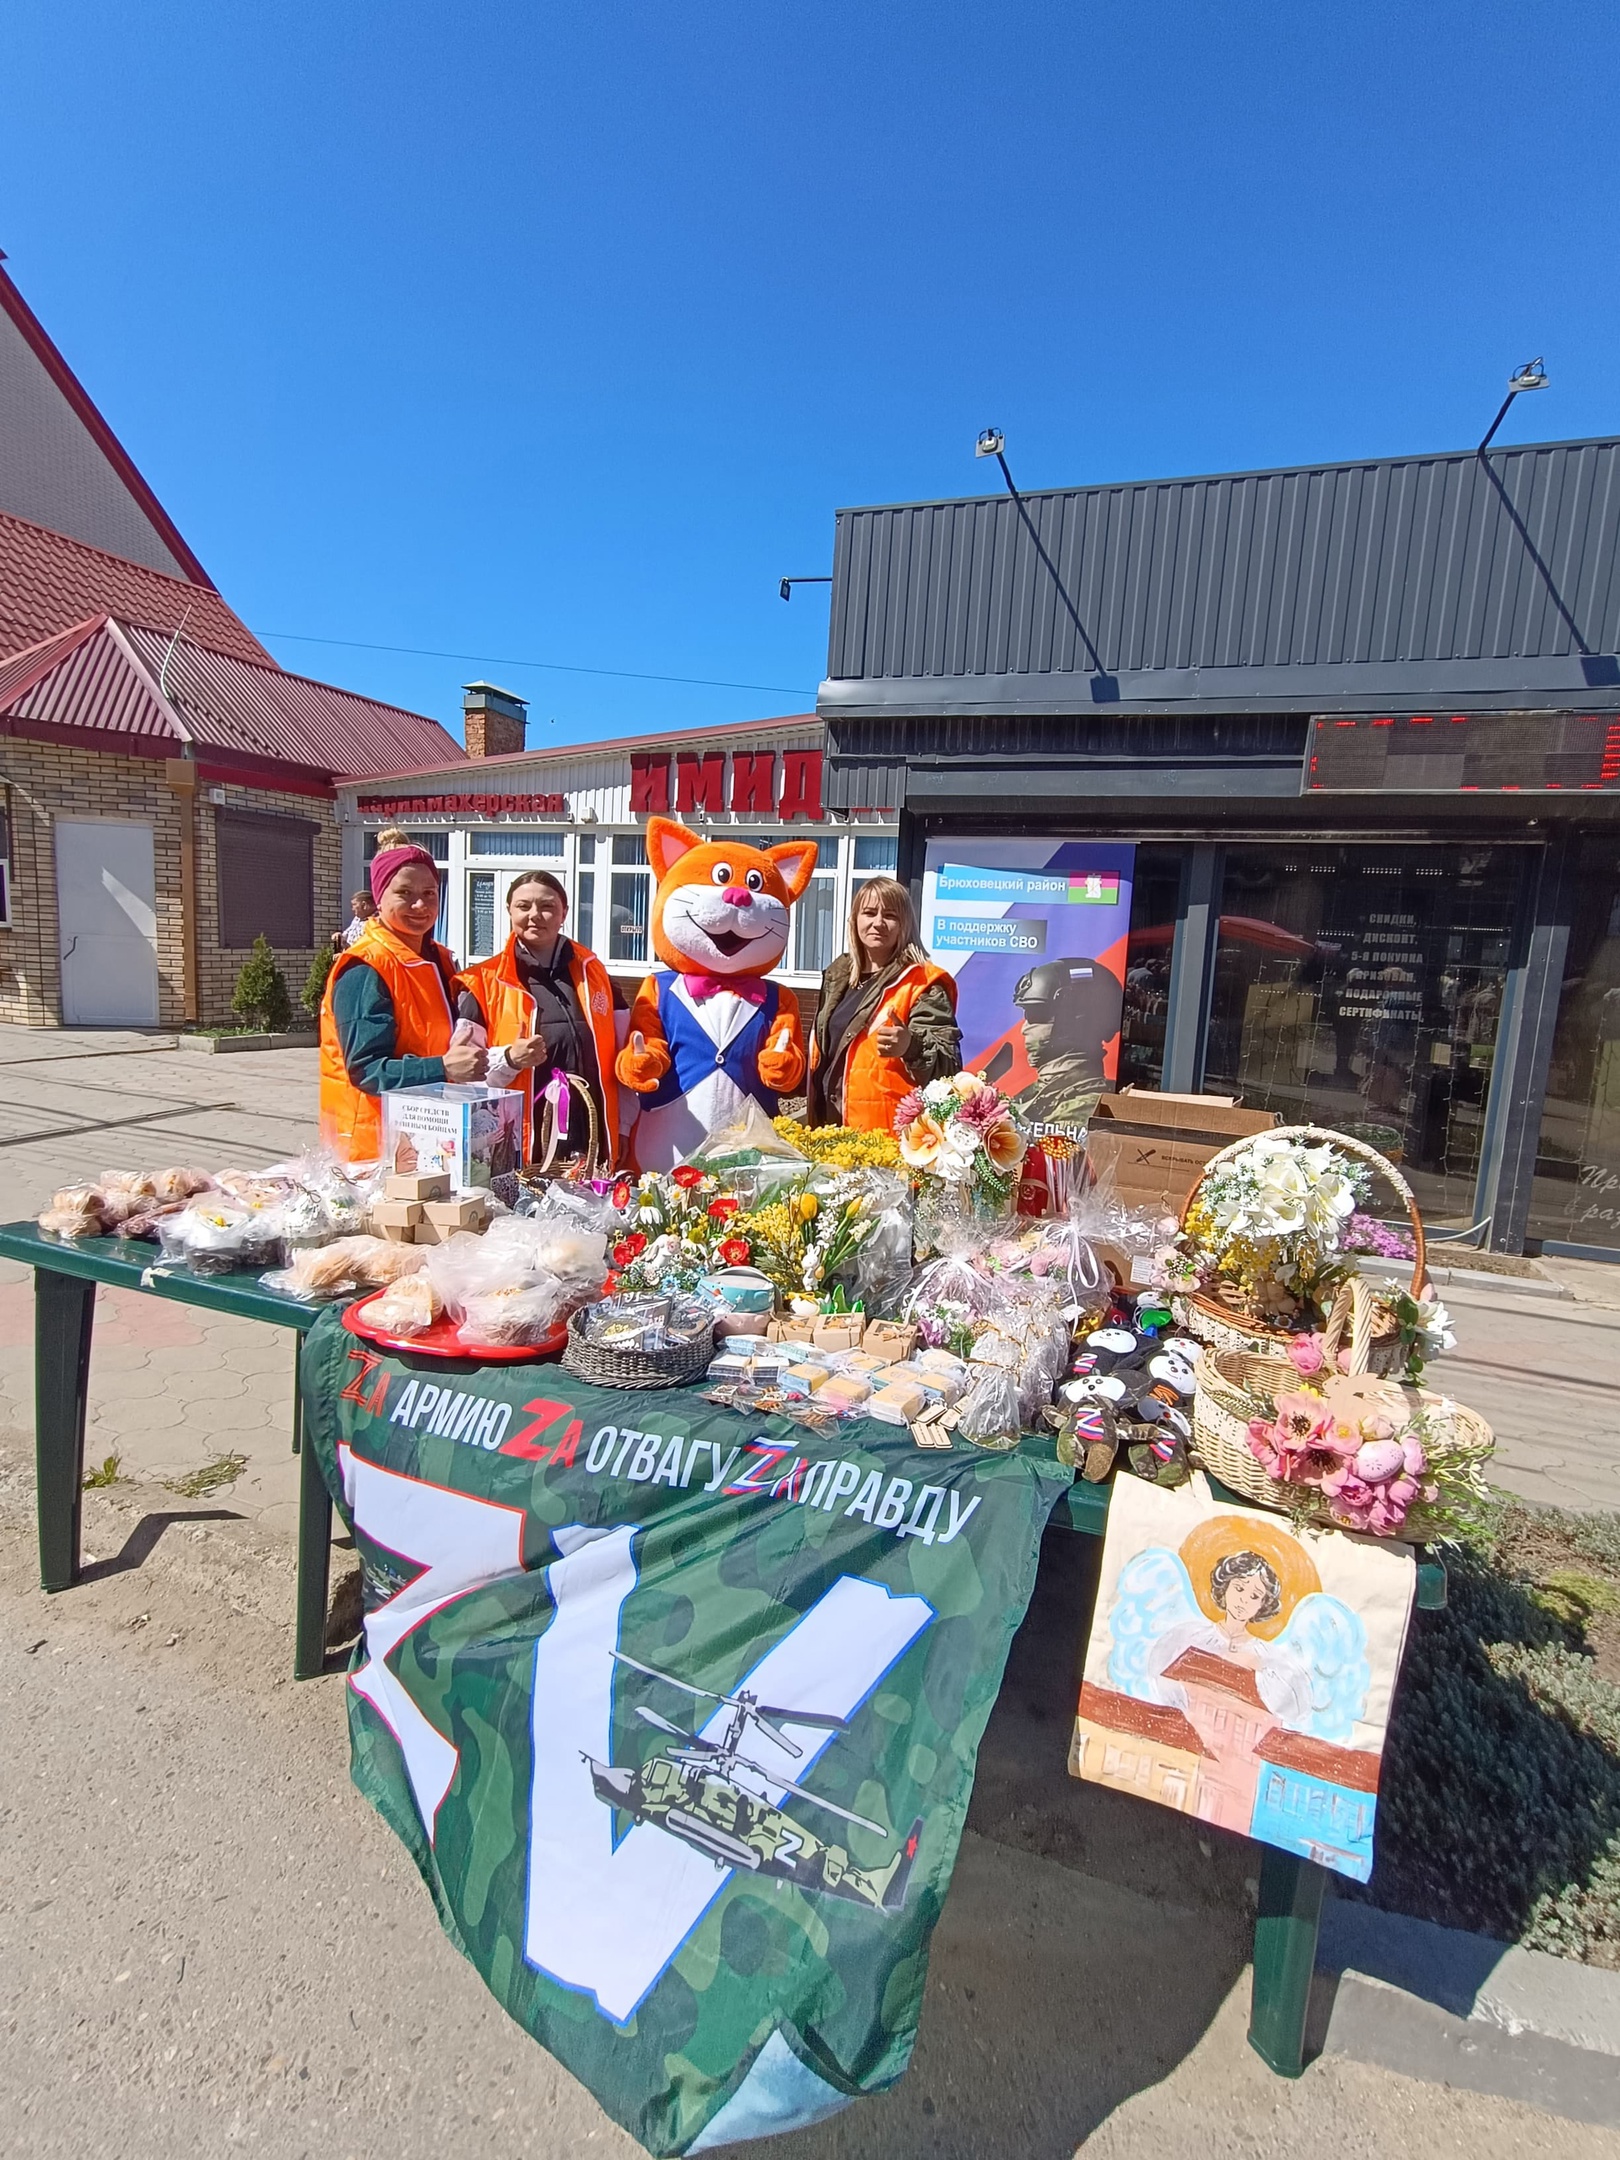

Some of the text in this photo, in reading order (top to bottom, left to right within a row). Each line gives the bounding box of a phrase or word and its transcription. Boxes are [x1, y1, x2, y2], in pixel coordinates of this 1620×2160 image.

[629, 749, 894, 820] ИМИД
[939, 875, 1066, 893] Брюховецкий район
[937, 918, 1017, 936] В поддержку
[935, 934, 1038, 949] участников СВО
[1582, 1165, 1620, 1194] Пр
[389, 1379, 513, 1451] АРМИЮ
[584, 1424, 741, 1493] ОТВАГУ
[799, 1459, 983, 1546] ПРАВДУ
